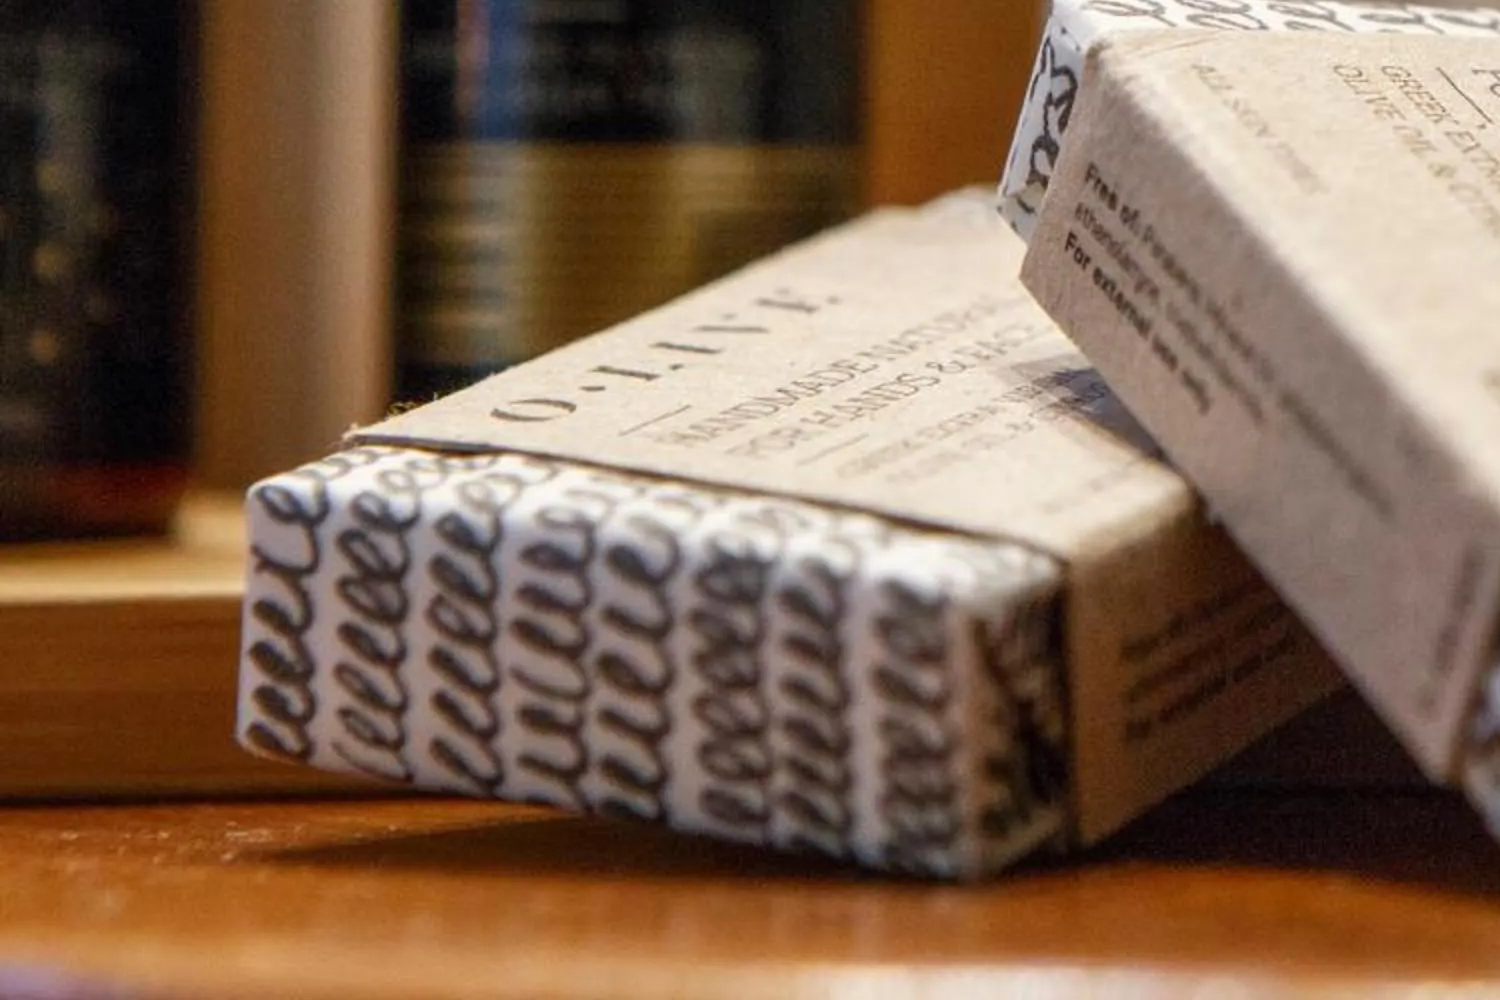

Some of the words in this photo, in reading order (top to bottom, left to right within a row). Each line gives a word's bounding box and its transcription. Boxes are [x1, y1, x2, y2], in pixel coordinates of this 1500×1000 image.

[1331, 63, 1408, 121] OLIVE
[1379, 63, 1461, 126] GREEK
[1064, 229, 1092, 273] For
